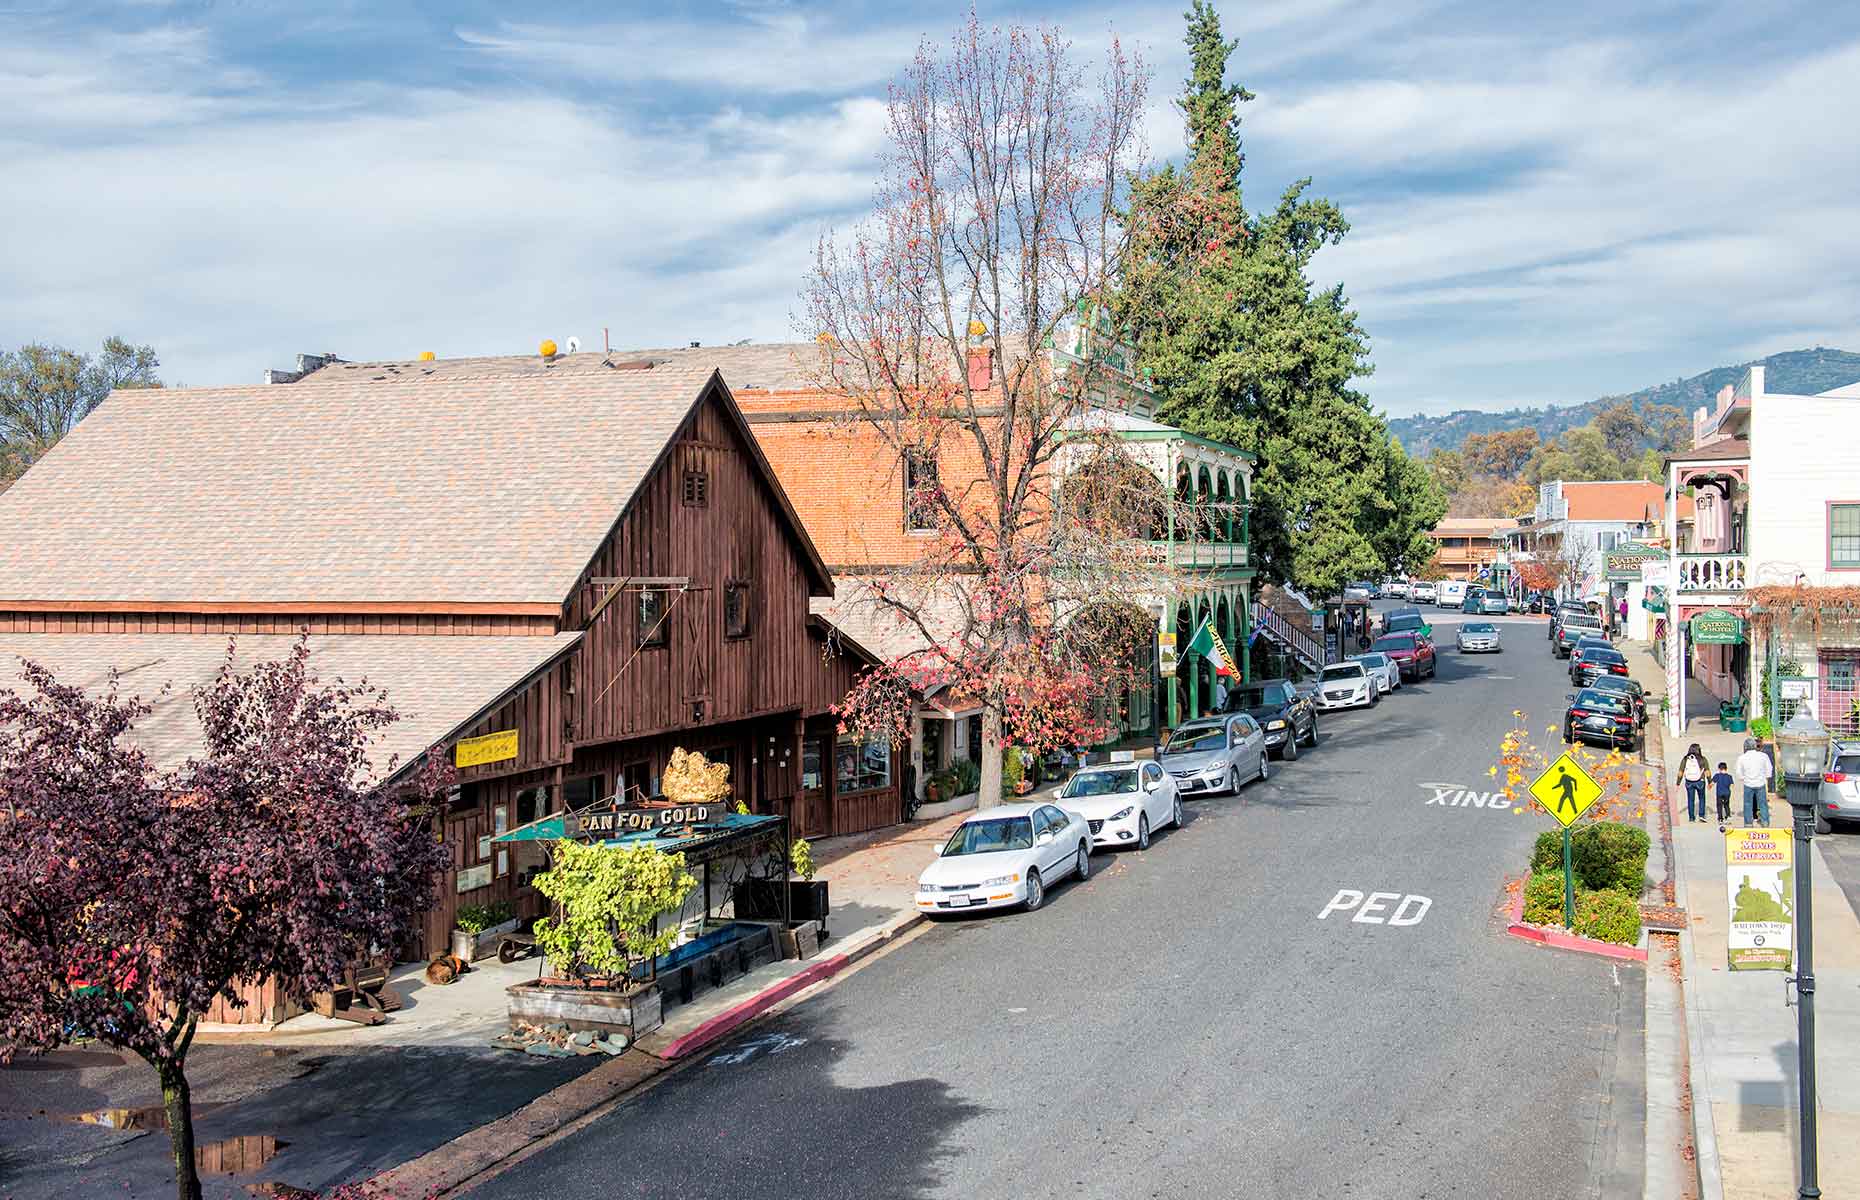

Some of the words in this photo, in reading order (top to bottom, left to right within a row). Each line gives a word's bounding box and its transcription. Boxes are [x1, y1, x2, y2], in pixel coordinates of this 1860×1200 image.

[1698, 622, 1733, 631] NATIONAL
[1425, 789, 1512, 809] XING
[579, 815, 613, 831] PAN
[617, 812, 653, 830] FOR
[661, 807, 707, 824] GOLD
[1749, 831, 1770, 840] THE
[1742, 841, 1776, 850] MOVIE
[1735, 851, 1784, 860] RAILROAD
[1317, 890, 1432, 926] PED
